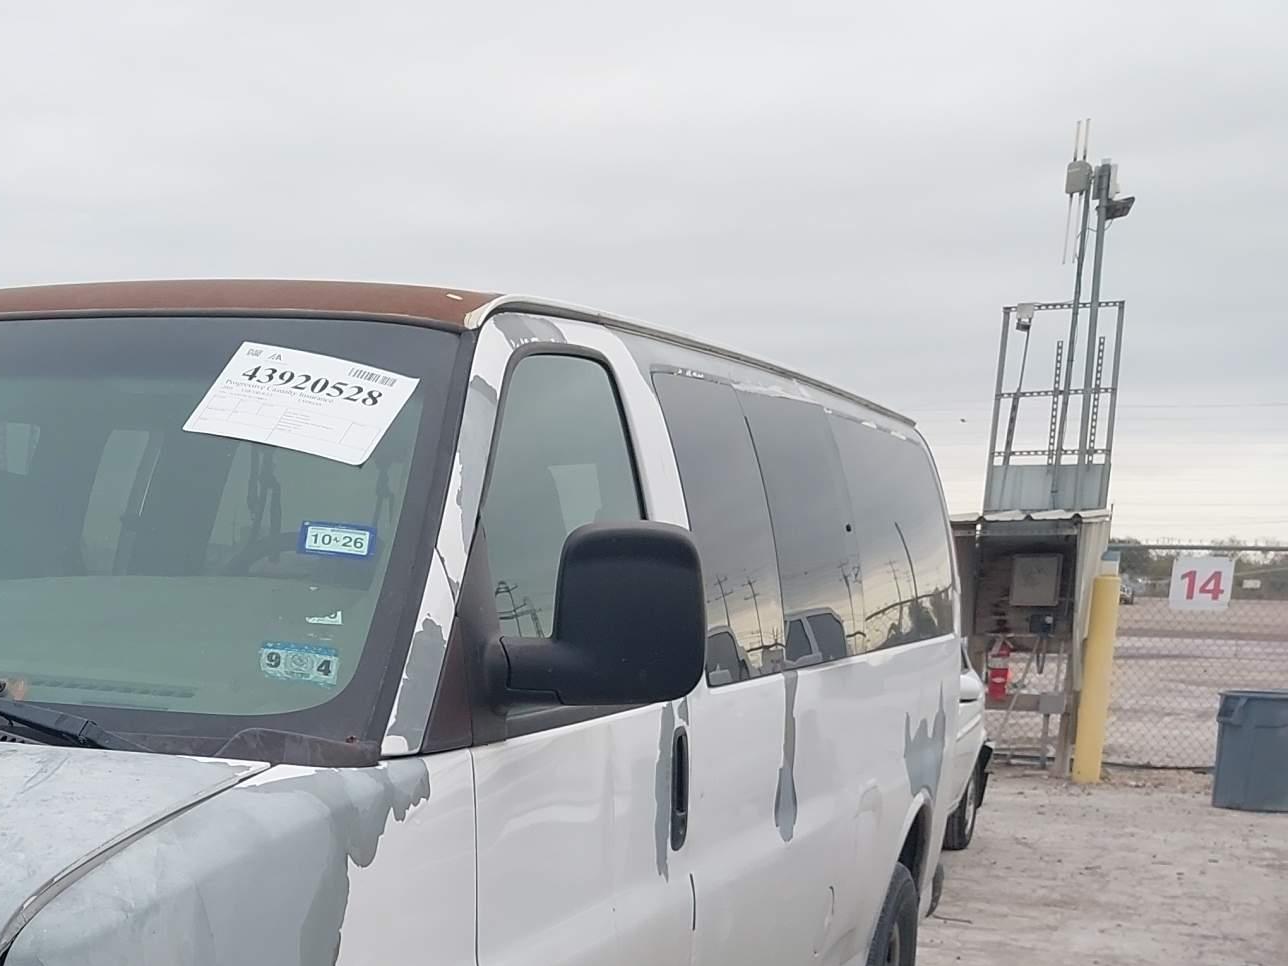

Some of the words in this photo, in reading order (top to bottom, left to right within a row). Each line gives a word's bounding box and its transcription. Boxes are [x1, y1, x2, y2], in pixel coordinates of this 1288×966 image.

[242, 366, 383, 406] 43920528
[1180, 570, 1225, 601] 14
[266, 651, 281, 668] 9
[317, 659, 332, 675] 4
